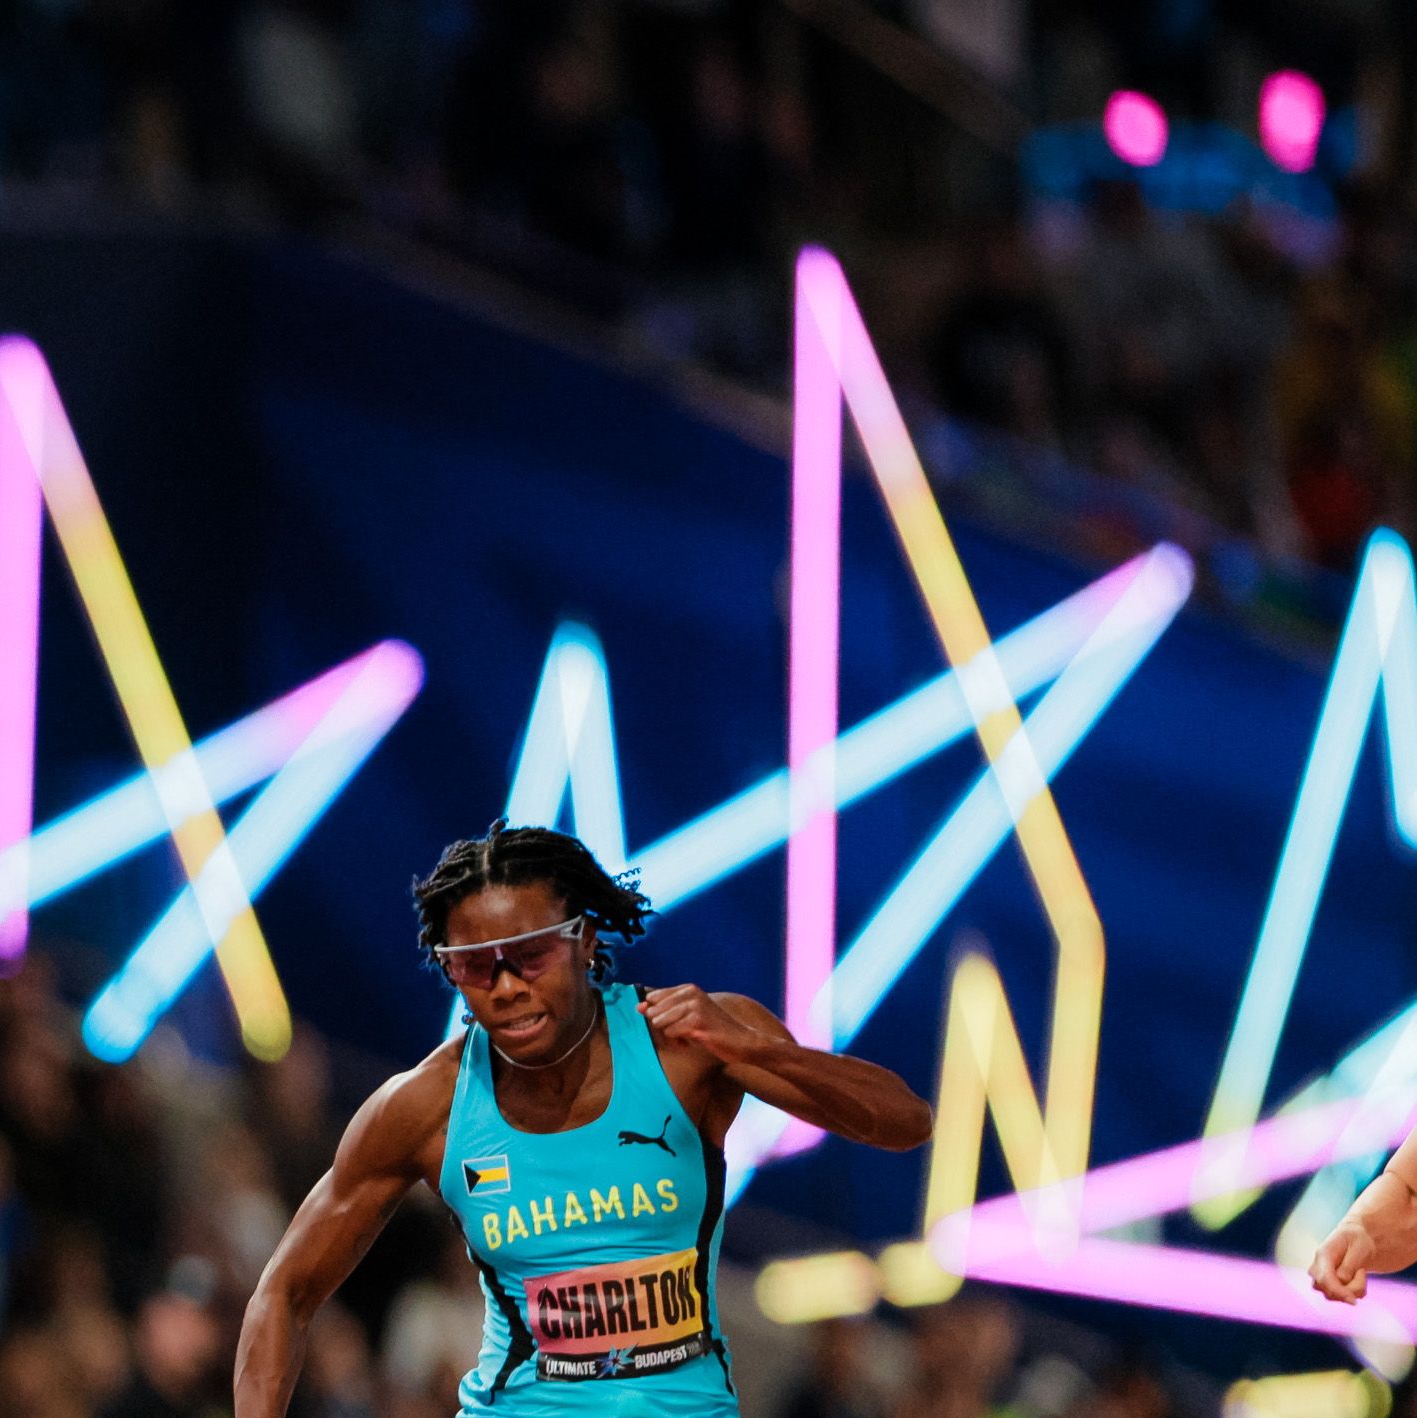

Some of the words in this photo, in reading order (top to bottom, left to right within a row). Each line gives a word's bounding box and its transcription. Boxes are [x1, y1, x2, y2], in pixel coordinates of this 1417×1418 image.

[482, 1179, 679, 1251] BAHAMAS
[536, 1263, 696, 1340] CHARLTON
[545, 1359, 597, 1375] ULTIMATE
[634, 1345, 688, 1370] BUDAPEST
